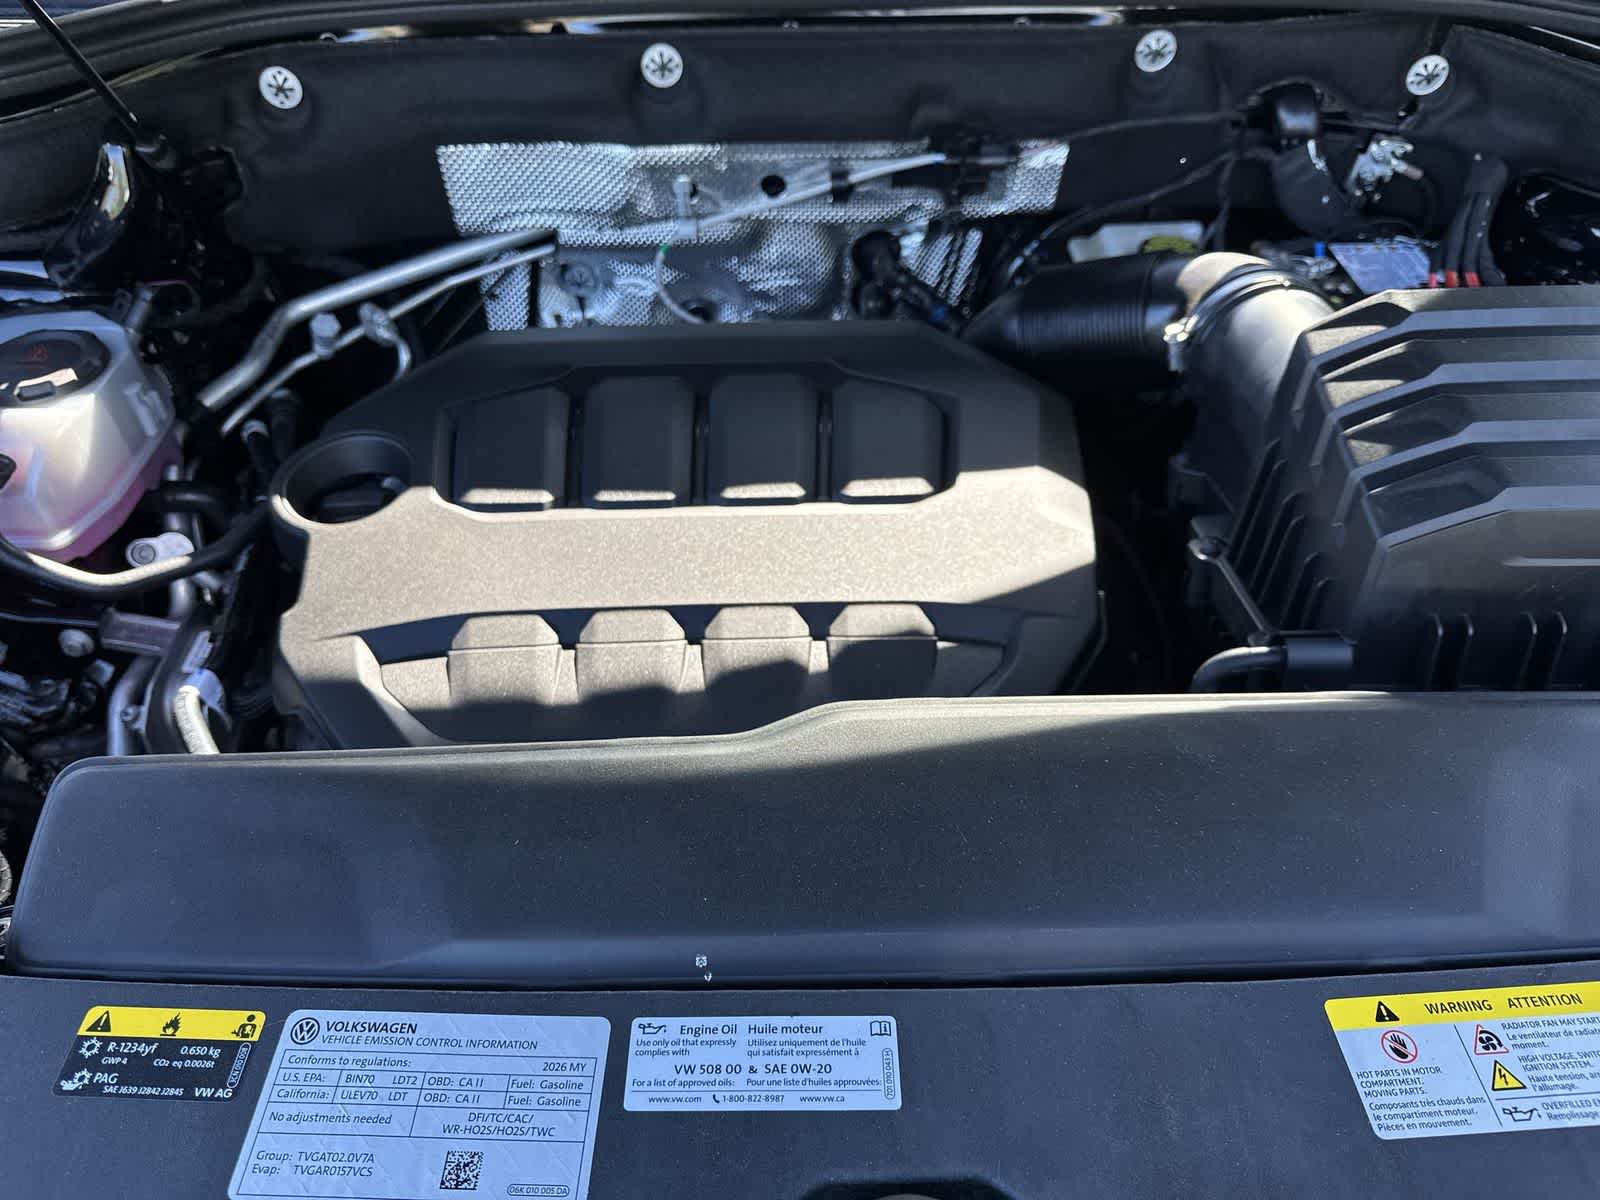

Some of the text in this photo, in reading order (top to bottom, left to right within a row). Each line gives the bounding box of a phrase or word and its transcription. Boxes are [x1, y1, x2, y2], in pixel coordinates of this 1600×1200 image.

[1507, 993, 1583, 1009] ATTENTION
[1424, 999, 1493, 1015] WARNING
[326, 1021, 417, 1034] VOLKSWAGEN
[748, 1023, 823, 1034] Huile moteur
[1501, 1020, 1542, 1030] RADIATOR
[1542, 1019, 1559, 1028] FAN
[1560, 1018, 1577, 1027] MAY
[680, 1024, 737, 1038] Engine Oil
[1506, 1033, 1518, 1041] Le
[1520, 1030, 1562, 1040] ventilateur
[1563, 1028, 1574, 1037] de
[322, 1034, 538, 1050] VEHICLE EMISSION CONTROL INFORMATION
[636, 1039, 651, 1047] Use
[652, 1039, 670, 1048] only
[671, 1038, 680, 1046] oil
[700, 1039, 737, 1048] expressly
[747, 1038, 866, 1049] Utilisez uniquement de l'huile
[1511, 1041, 1550, 1050] moment.
[107, 1042, 159, 1056] R-1234yf
[180, 1046, 221, 1058] 0.650 kg
[635, 1048, 690, 1058] complies with
[747, 1048, 860, 1059] qui satisfait expressément à
[101, 1056, 128, 1065] GWP 4
[288, 1054, 411, 1068] Conforms to regulations:
[1517, 1054, 1539, 1063] HIGH
[172, 1060, 183, 1069] eq
[184, 1060, 215, 1068] 0.0026t
[542, 1062, 587, 1072] 2026 MY
[674, 1063, 832, 1075] VW 508 00 & SAE 0W-20
[1522, 1062, 1559, 1072] IGNITION
[93, 1072, 119, 1084] PAG
[282, 1072, 326, 1082] U.S. EPA:
[1356, 1066, 1441, 1080] HOT PARTS IN MOTOR
[1527, 1074, 1554, 1083] Haute
[345, 1074, 418, 1086] BIN70 LDT2
[427, 1076, 454, 1087] OBD:
[458, 1077, 472, 1087] CA
[510, 1079, 584, 1090] Fuel: Gasoline
[632, 1079, 646, 1087] For
[653, 1078, 666, 1087] list
[667, 1078, 677, 1087] of
[678, 1078, 717, 1088] approved
[718, 1078, 735, 1086] oils:
[746, 1078, 765, 1086] Pour
[783, 1078, 800, 1086] liste
[801, 1078, 833, 1086] d'huiles
[833, 1078, 882, 1088] approuvées:
[1360, 1077, 1424, 1089] COMPARTMENT.
[103, 1085, 119, 1093] SAE
[195, 1088, 234, 1098] VW AG
[277, 1088, 330, 1100] California:
[1364, 1088, 1398, 1098] MOVING
[340, 1090, 408, 1101] ULEV70 LDT
[423, 1092, 450, 1103] OBD:
[455, 1093, 469, 1104] CA
[722, 1094, 785, 1104] 1-800-822-8987
[507, 1096, 581, 1107] Fuel: Gasoline
[1369, 1096, 1486, 1111] Composants très chauds dans
[1541, 1099, 1592, 1110] OVERFILLED
[269, 1111, 392, 1125] No adjustments needed
[468, 1112, 534, 1124] DFI/TC/CAC/
[1372, 1108, 1478, 1122] le compartiment moteur.
[1377, 1118, 1472, 1132] Pièces en mouvement.
[256, 1150, 293, 1164] Group:
[252, 1163, 281, 1176] Evap:
